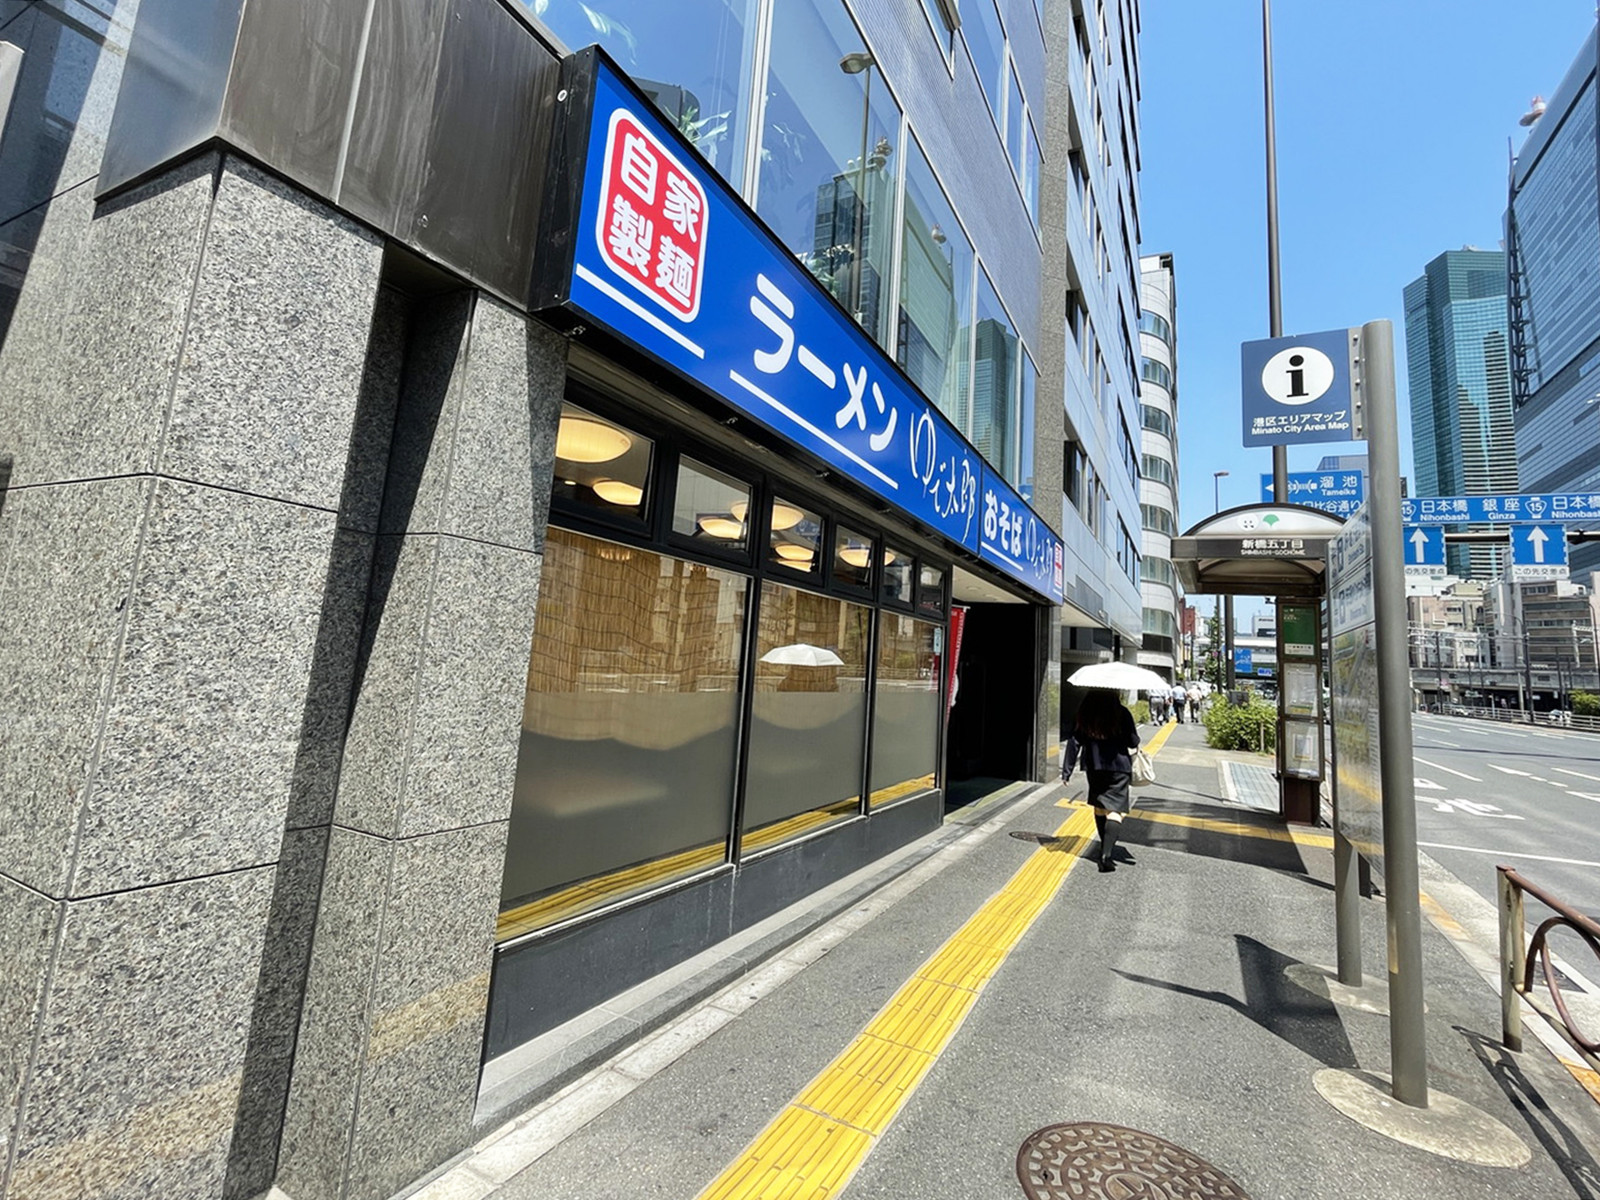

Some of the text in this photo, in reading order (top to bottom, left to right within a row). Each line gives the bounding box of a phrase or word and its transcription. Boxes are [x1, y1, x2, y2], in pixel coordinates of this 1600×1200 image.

[750, 273, 898, 452] ラーメン
[1253, 410, 1346, 427] 港区エリアマップ
[1251, 421, 1349, 435] Minato City Area Map
[1321, 488, 1357, 496] Tameike
[1421, 500, 1468, 513] 日本橋
[1482, 498, 1520, 512] 銀座
[1530, 502, 1543, 511] 15
[1420, 512, 1516, 521] Nihonbashi Ginza
[1552, 511, 1600, 519] Nihonbas
[983, 489, 1023, 558] おそば
[1242, 539, 1304, 549] 新橋五丁目
